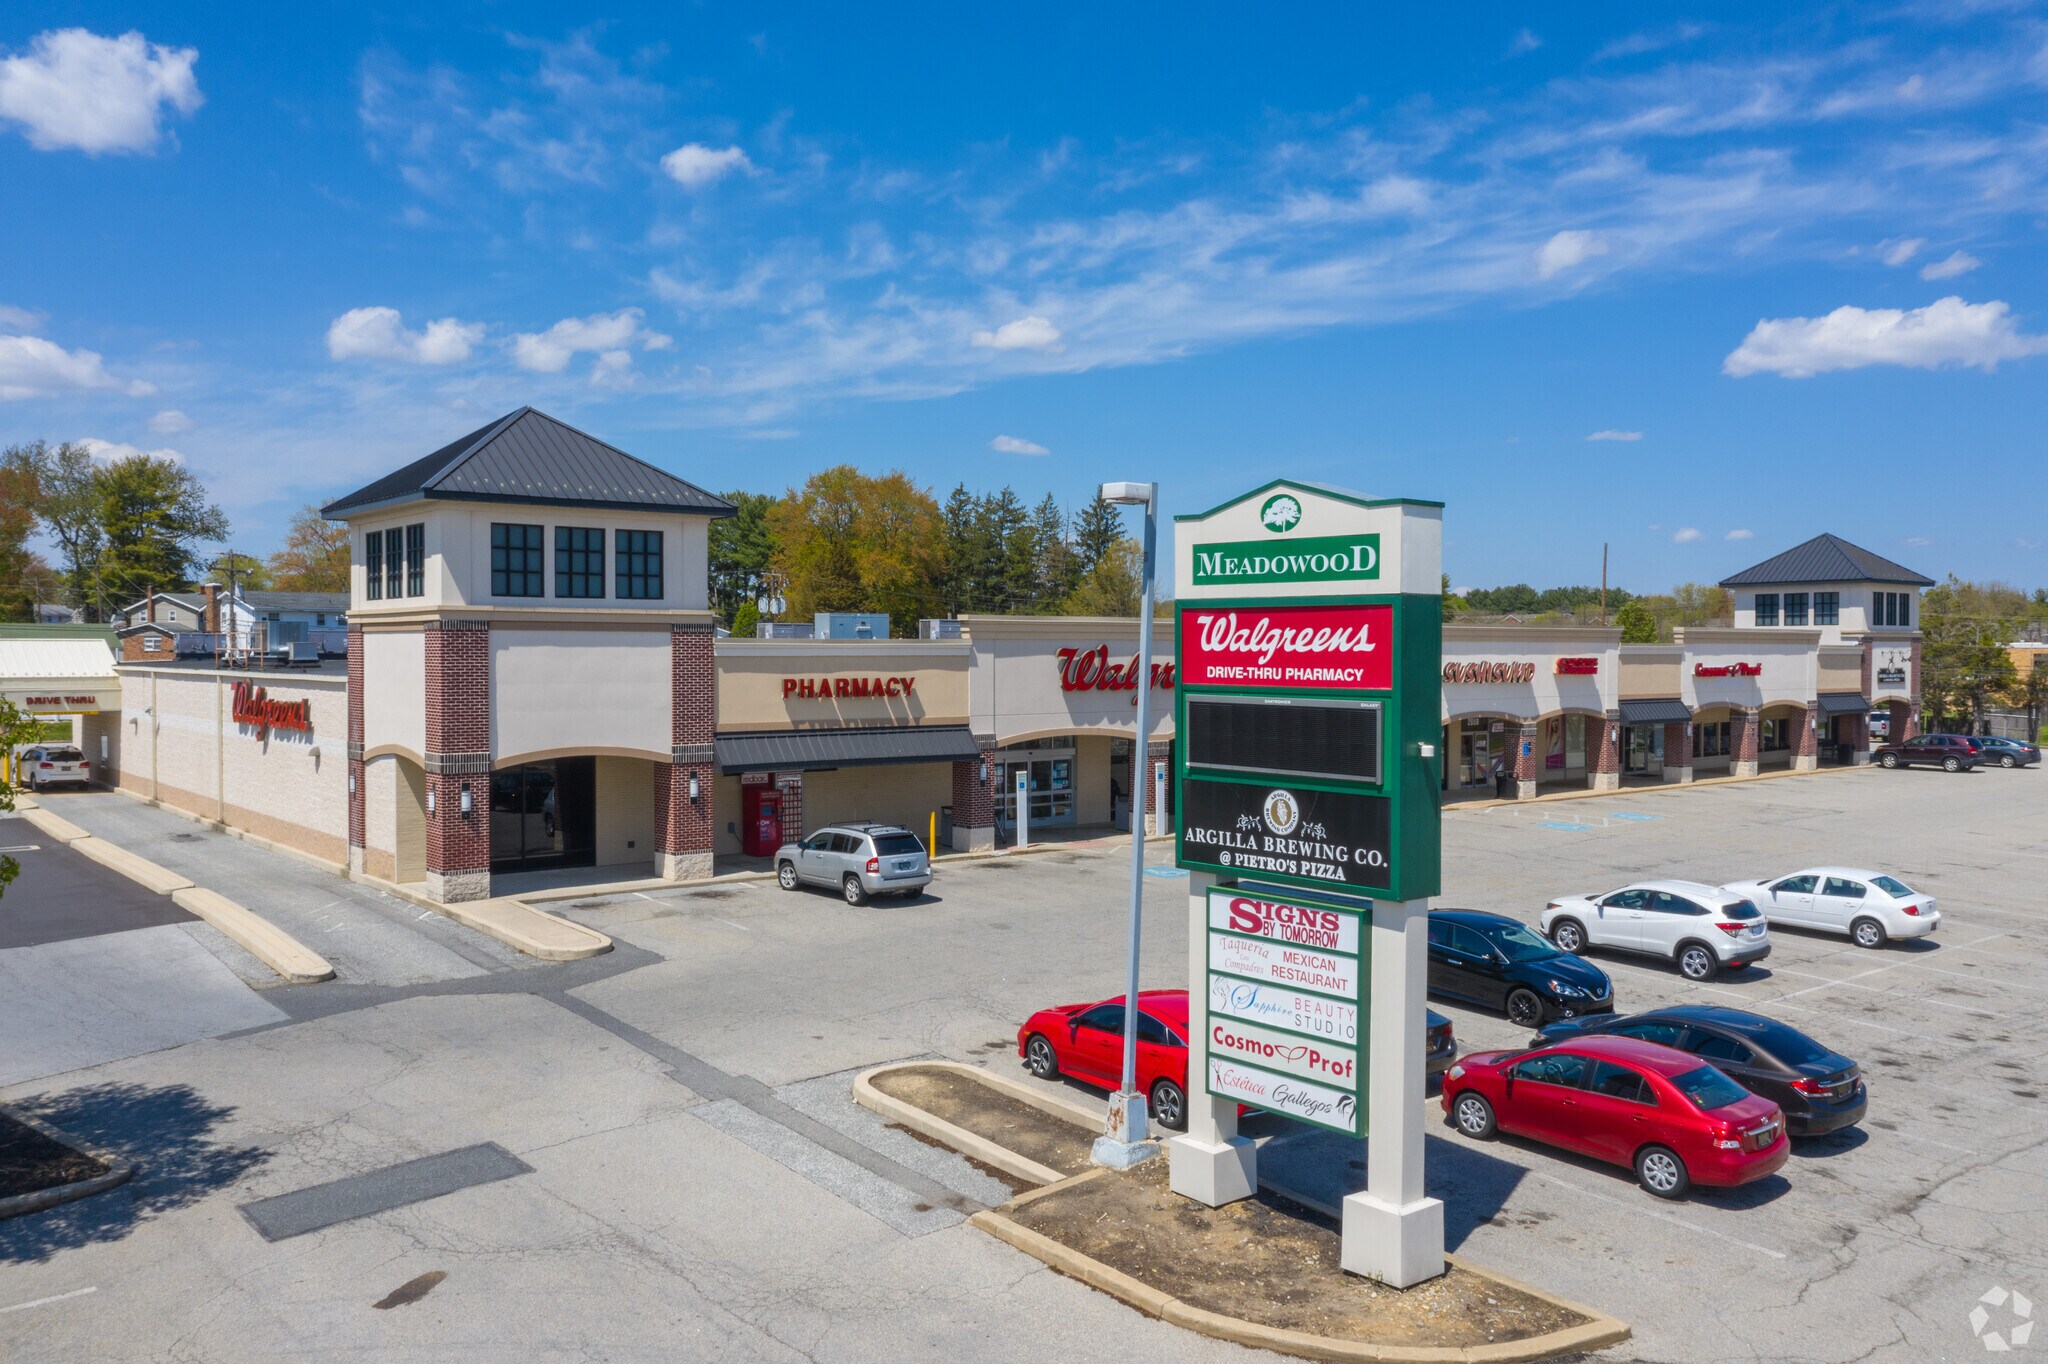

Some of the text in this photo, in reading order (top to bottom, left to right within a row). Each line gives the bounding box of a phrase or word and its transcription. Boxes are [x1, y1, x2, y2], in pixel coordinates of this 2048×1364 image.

[1197, 545, 1377, 577] MEADOWOOD
[1197, 612, 1376, 665] Walgreens
[782, 676, 915, 699] PHARMACY
[1206, 665, 1364, 682] DRIVE-THRU PHARMACY
[26, 695, 96, 705] DRIVE THRU
[231, 679, 312, 741] Walgreens
[1185, 827, 1388, 868] ARGILLA BREWING CO.
[1220, 850, 1346, 881] @ PIETRO'S PIZZA
[1229, 897, 1340, 933] SIGNS
[1219, 935, 1270, 959] Taqueria
[1262, 920, 1339, 949] BY TOMORROW
[1224, 958, 1264, 975] Compadres
[1283, 951, 1336, 973] MEXICAN
[1271, 964, 1348, 991] RESTAURANT
[1230, 984, 1293, 1015] Sapphire
[1294, 997, 1354, 1022] BEAUTY
[1294, 1013, 1355, 1039] STUDIO
[1213, 1025, 1353, 1078] Cosmo Prof
[1223, 1068, 1333, 1116] Estética Gallegos
